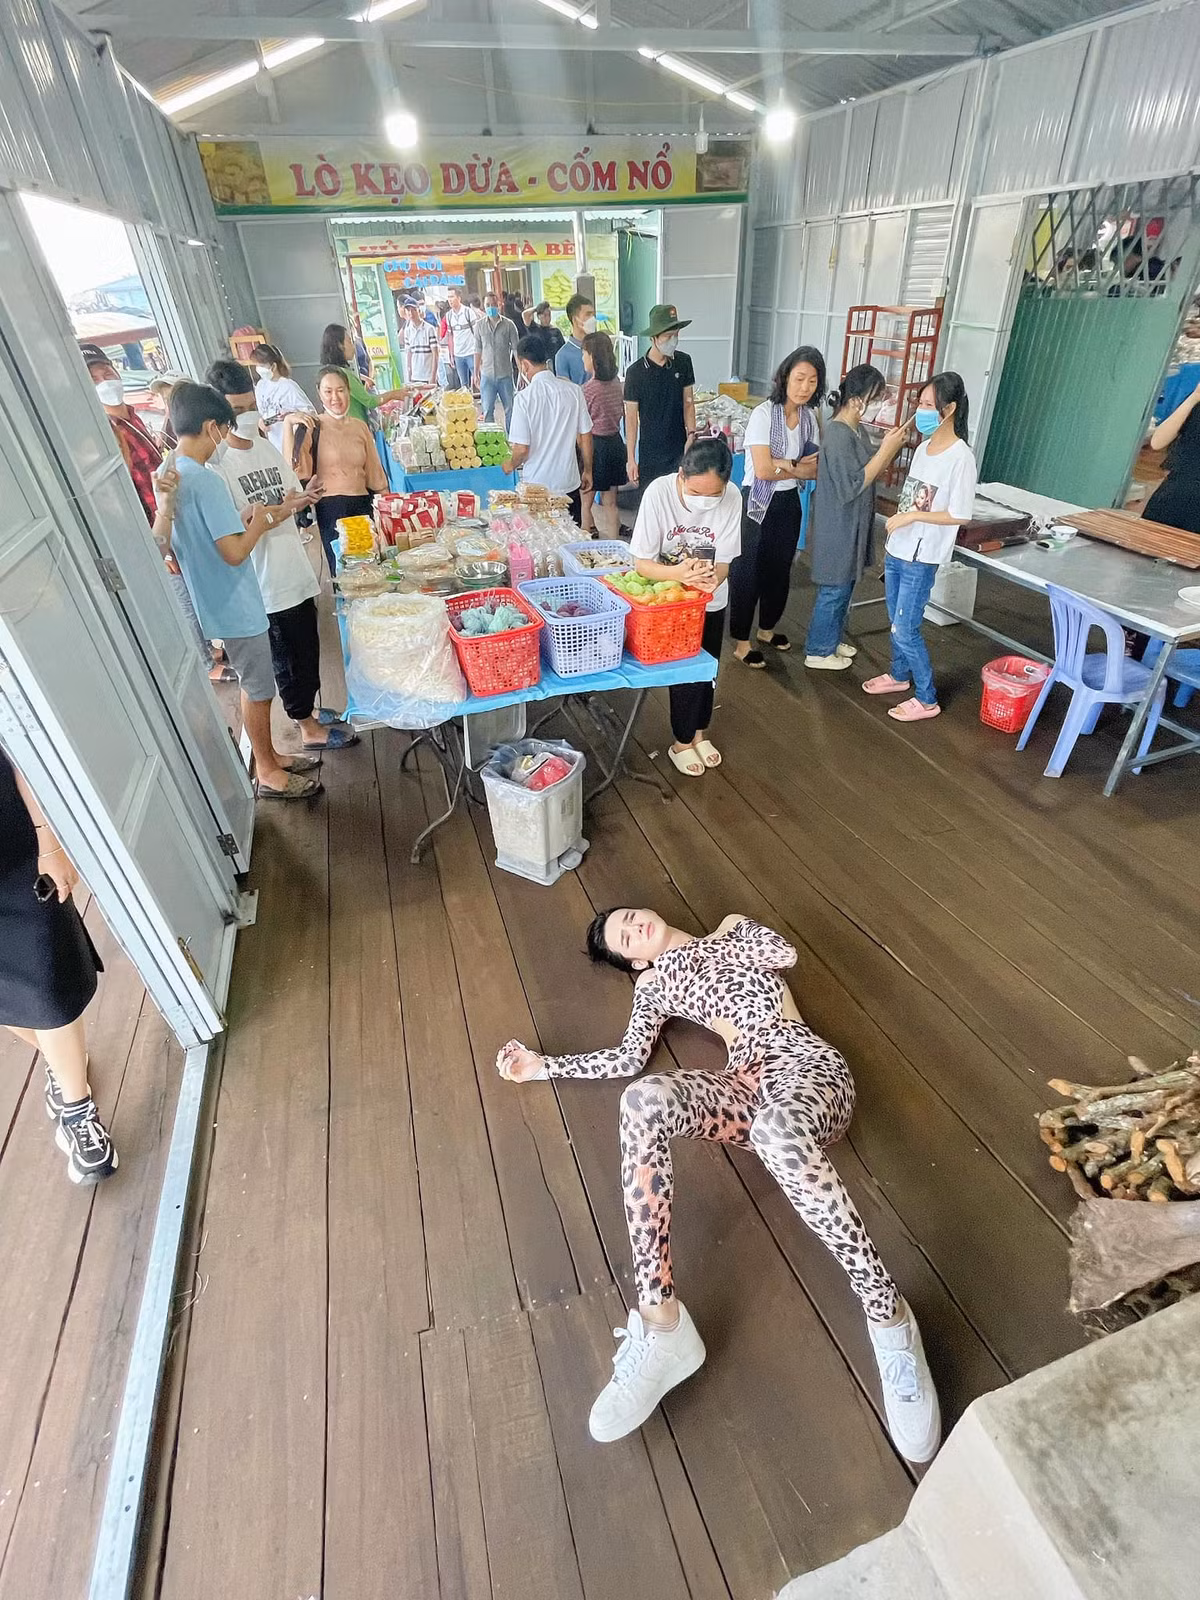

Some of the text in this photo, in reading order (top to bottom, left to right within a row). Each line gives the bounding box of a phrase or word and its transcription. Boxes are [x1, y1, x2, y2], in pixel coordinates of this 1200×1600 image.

[289, 154, 341, 197] LÒ
[351, 162, 430, 204] KẸO
[440, 153, 519, 194] DỪA
[547, 146, 618, 192] CỐM
[627, 142, 673, 191] NỔ
